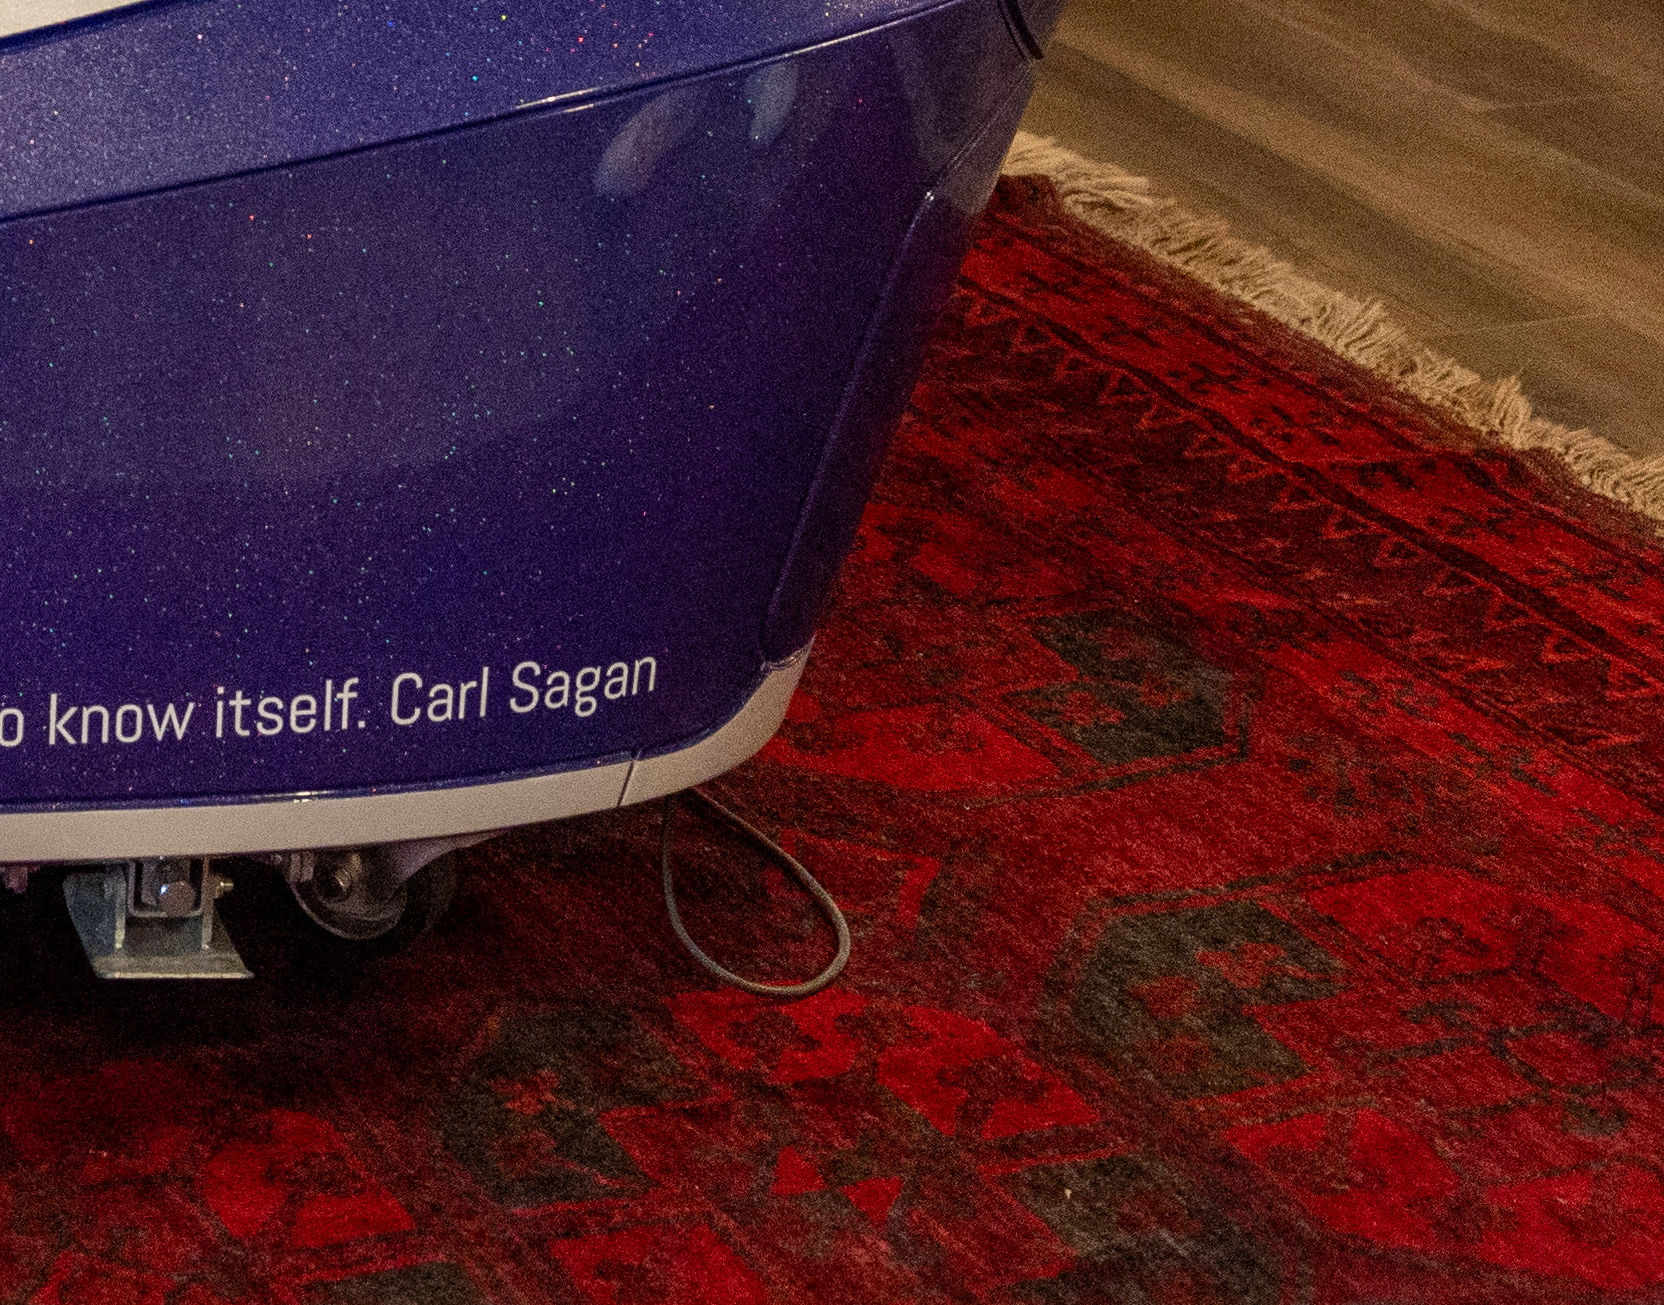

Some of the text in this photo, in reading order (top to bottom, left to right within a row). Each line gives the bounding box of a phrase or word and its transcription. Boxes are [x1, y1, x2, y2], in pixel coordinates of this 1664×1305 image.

[48, 693, 196, 746] know
[215, 677, 369, 739] itself.
[391, 666, 489, 727] Carl
[509, 656, 658, 719] Sagan
